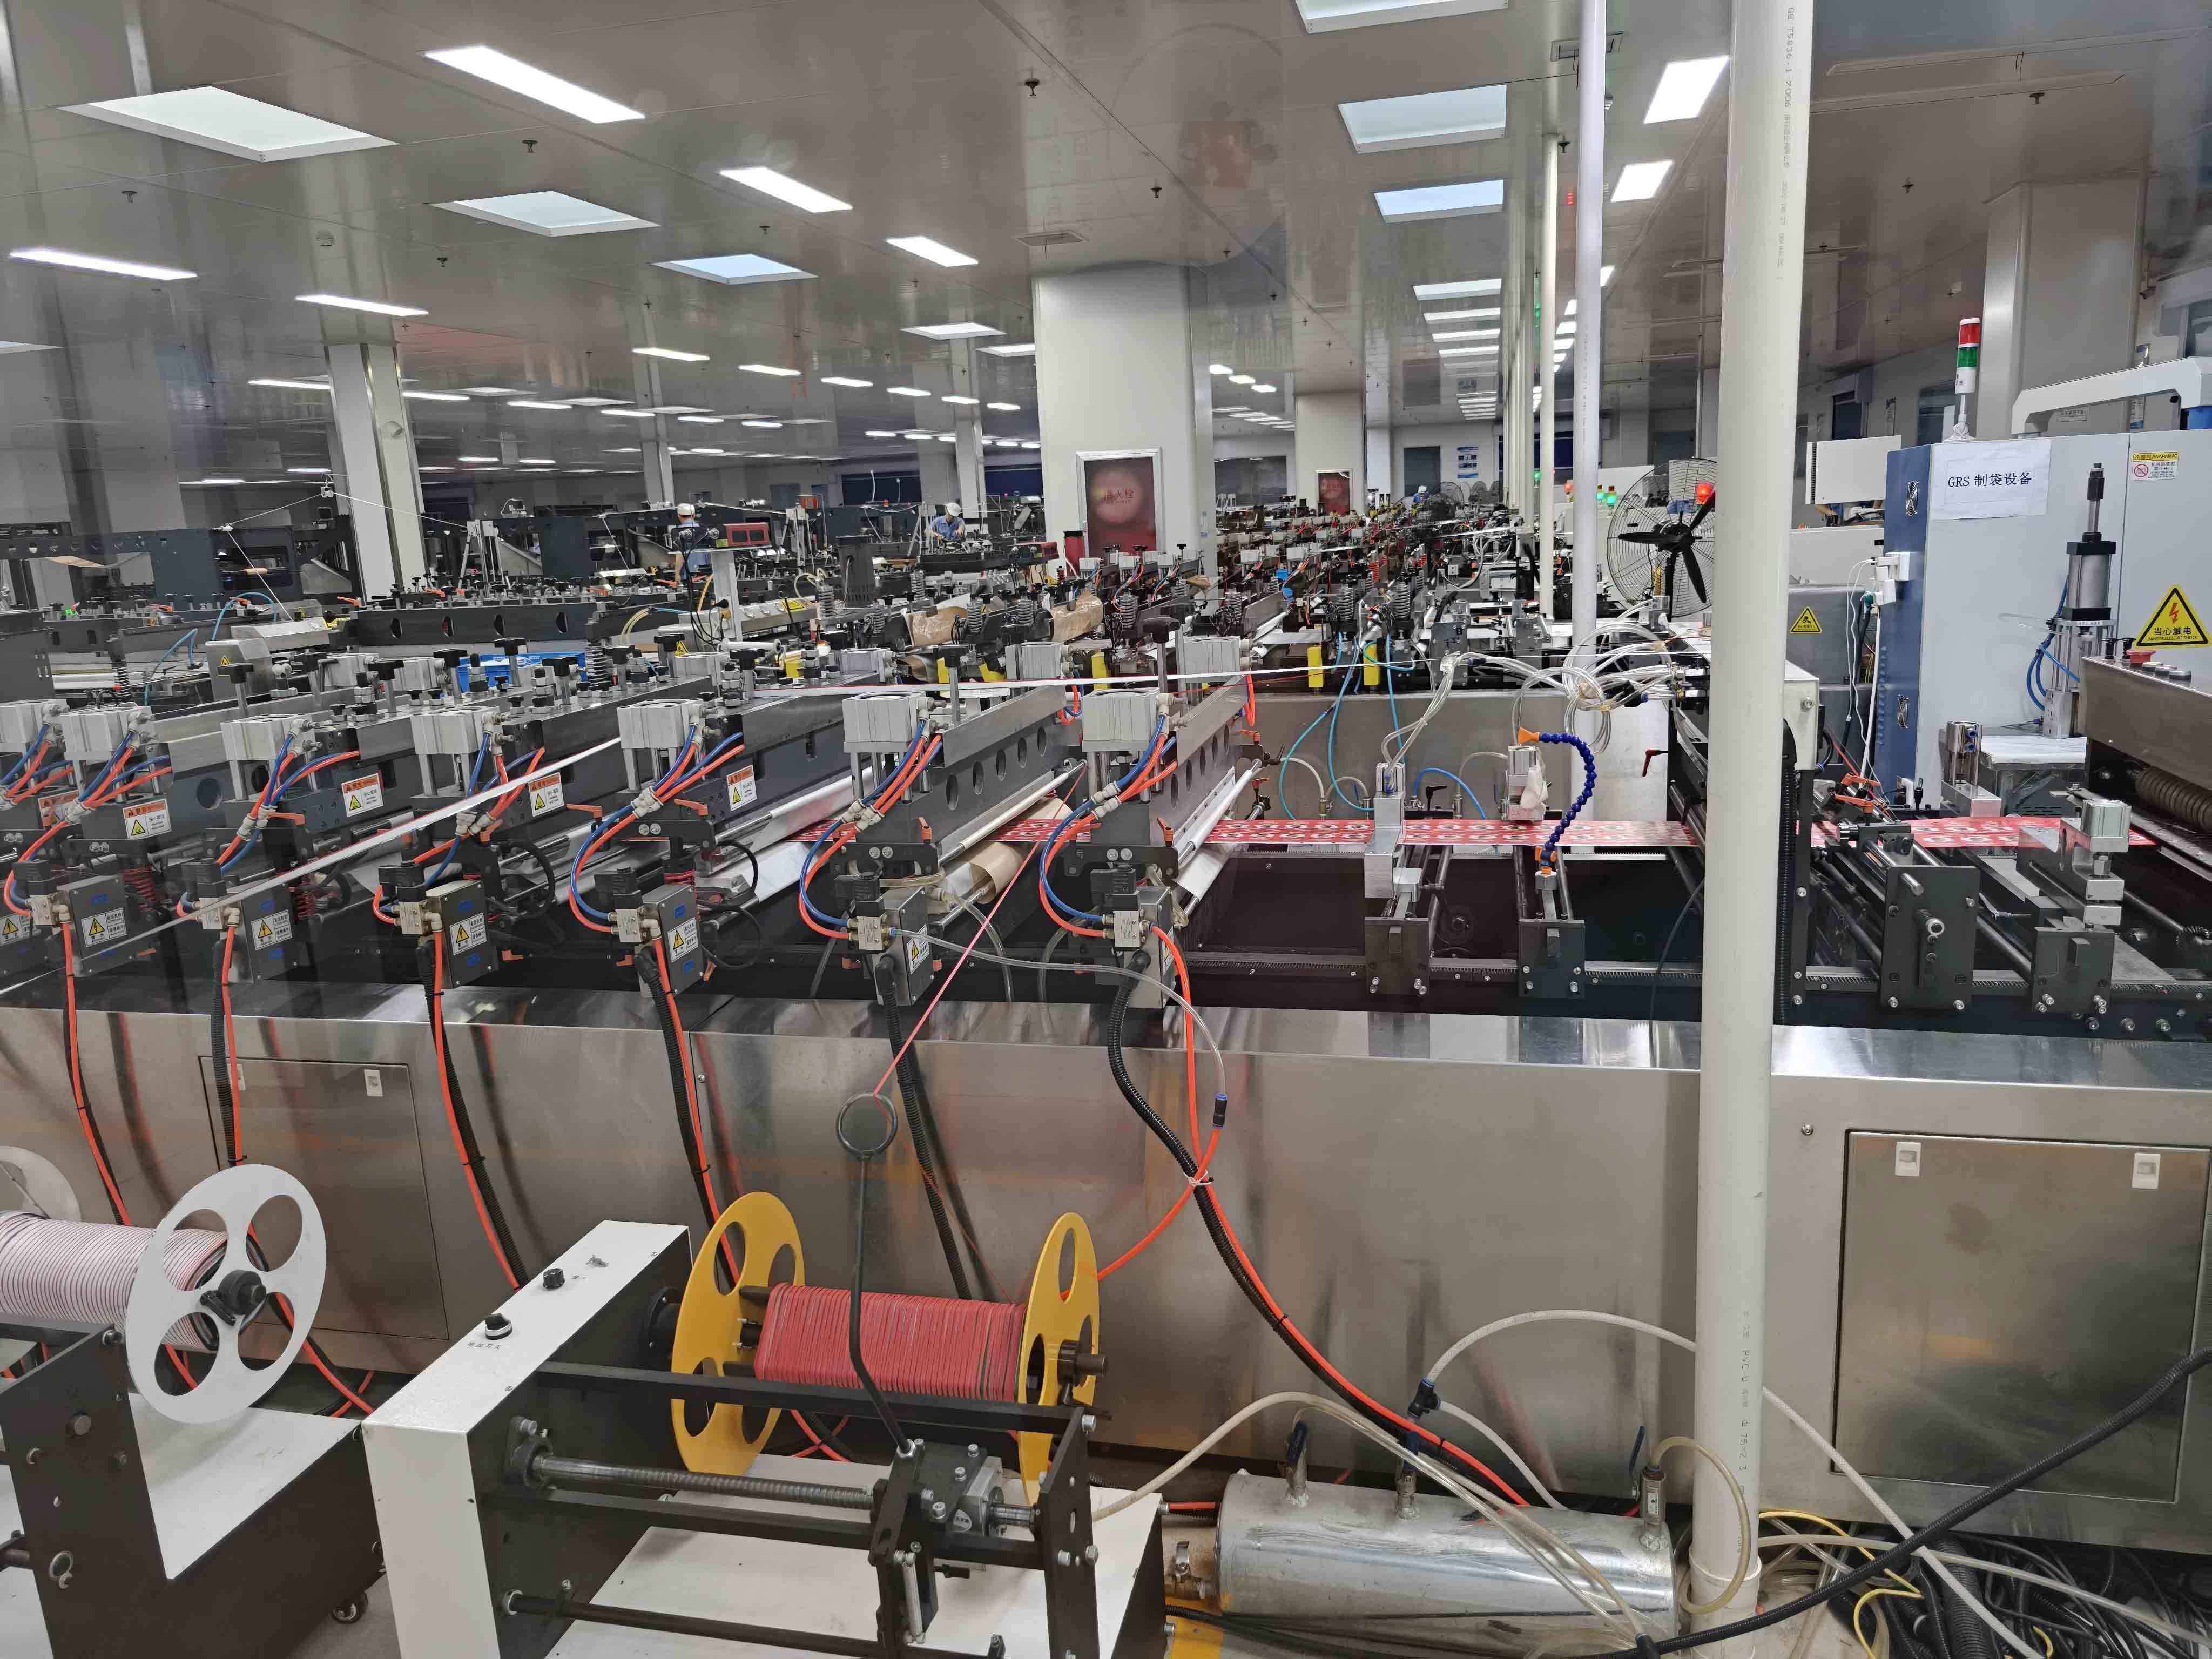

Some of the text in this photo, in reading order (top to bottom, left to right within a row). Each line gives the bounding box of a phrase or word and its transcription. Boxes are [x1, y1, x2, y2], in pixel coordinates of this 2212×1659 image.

[1948, 471, 2032, 487] GRS 制袋设备
[2154, 626, 2191, 636] 当心触电
